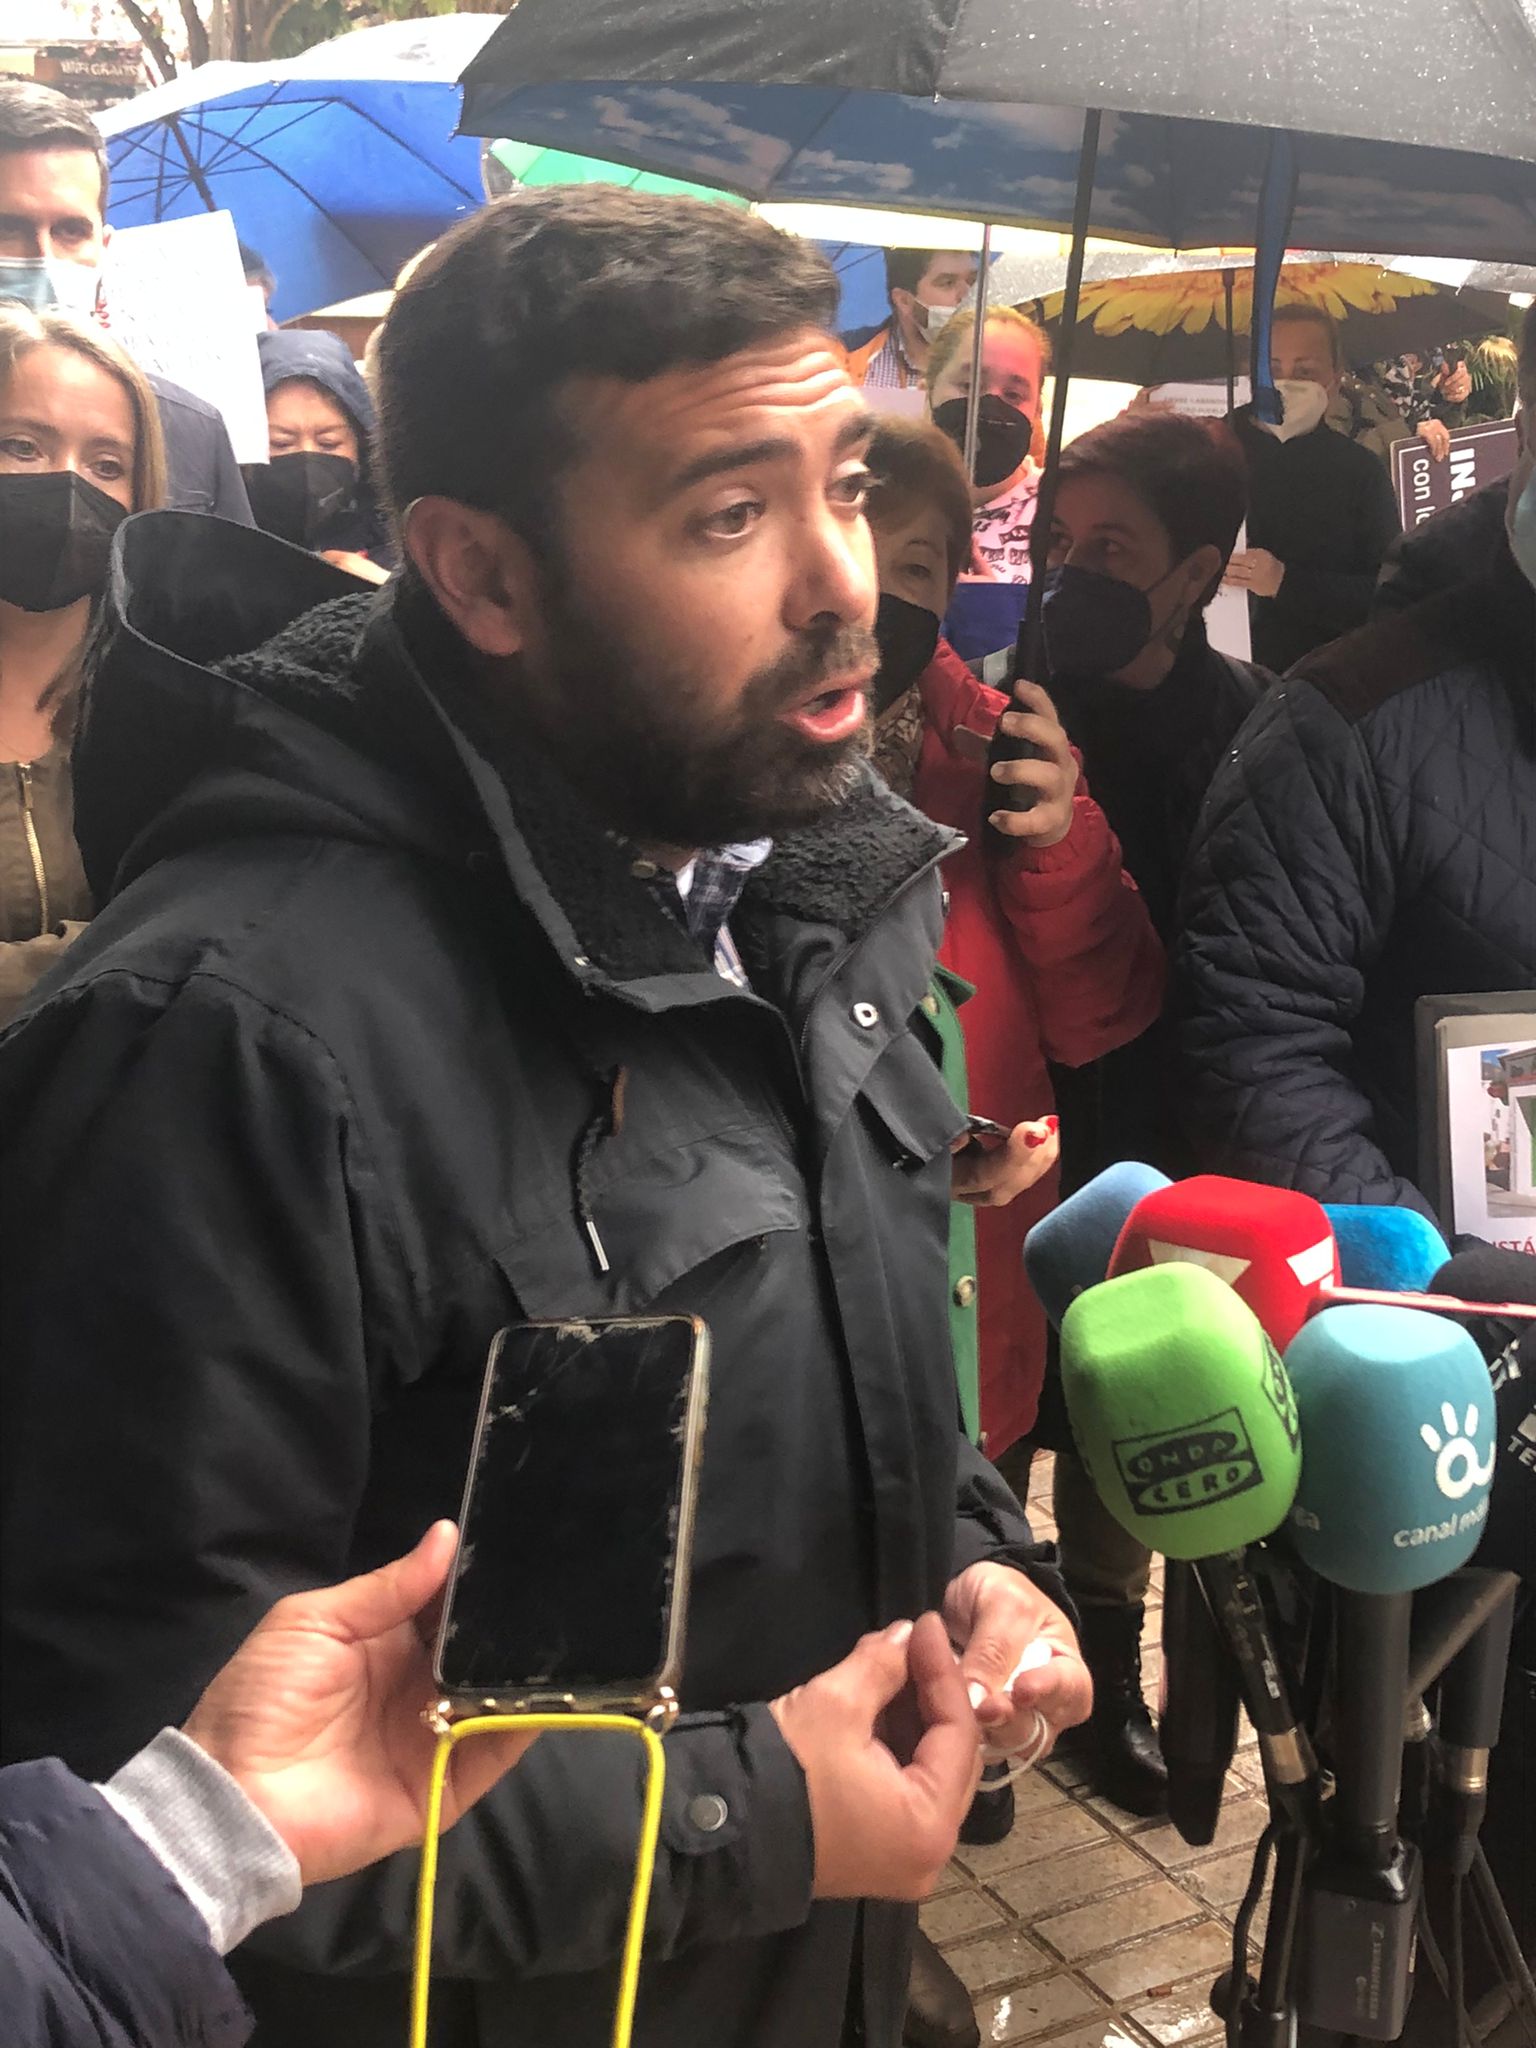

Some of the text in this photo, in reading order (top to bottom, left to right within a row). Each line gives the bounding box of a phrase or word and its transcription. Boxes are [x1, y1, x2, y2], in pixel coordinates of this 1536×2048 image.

[1413, 459, 1431, 501] con
[1137, 1437, 1227, 1474] ONDA
[1507, 1435, 1536, 1474] TE
[1152, 1466, 1241, 1503] CERO
[1393, 1513, 1457, 1549] canal
